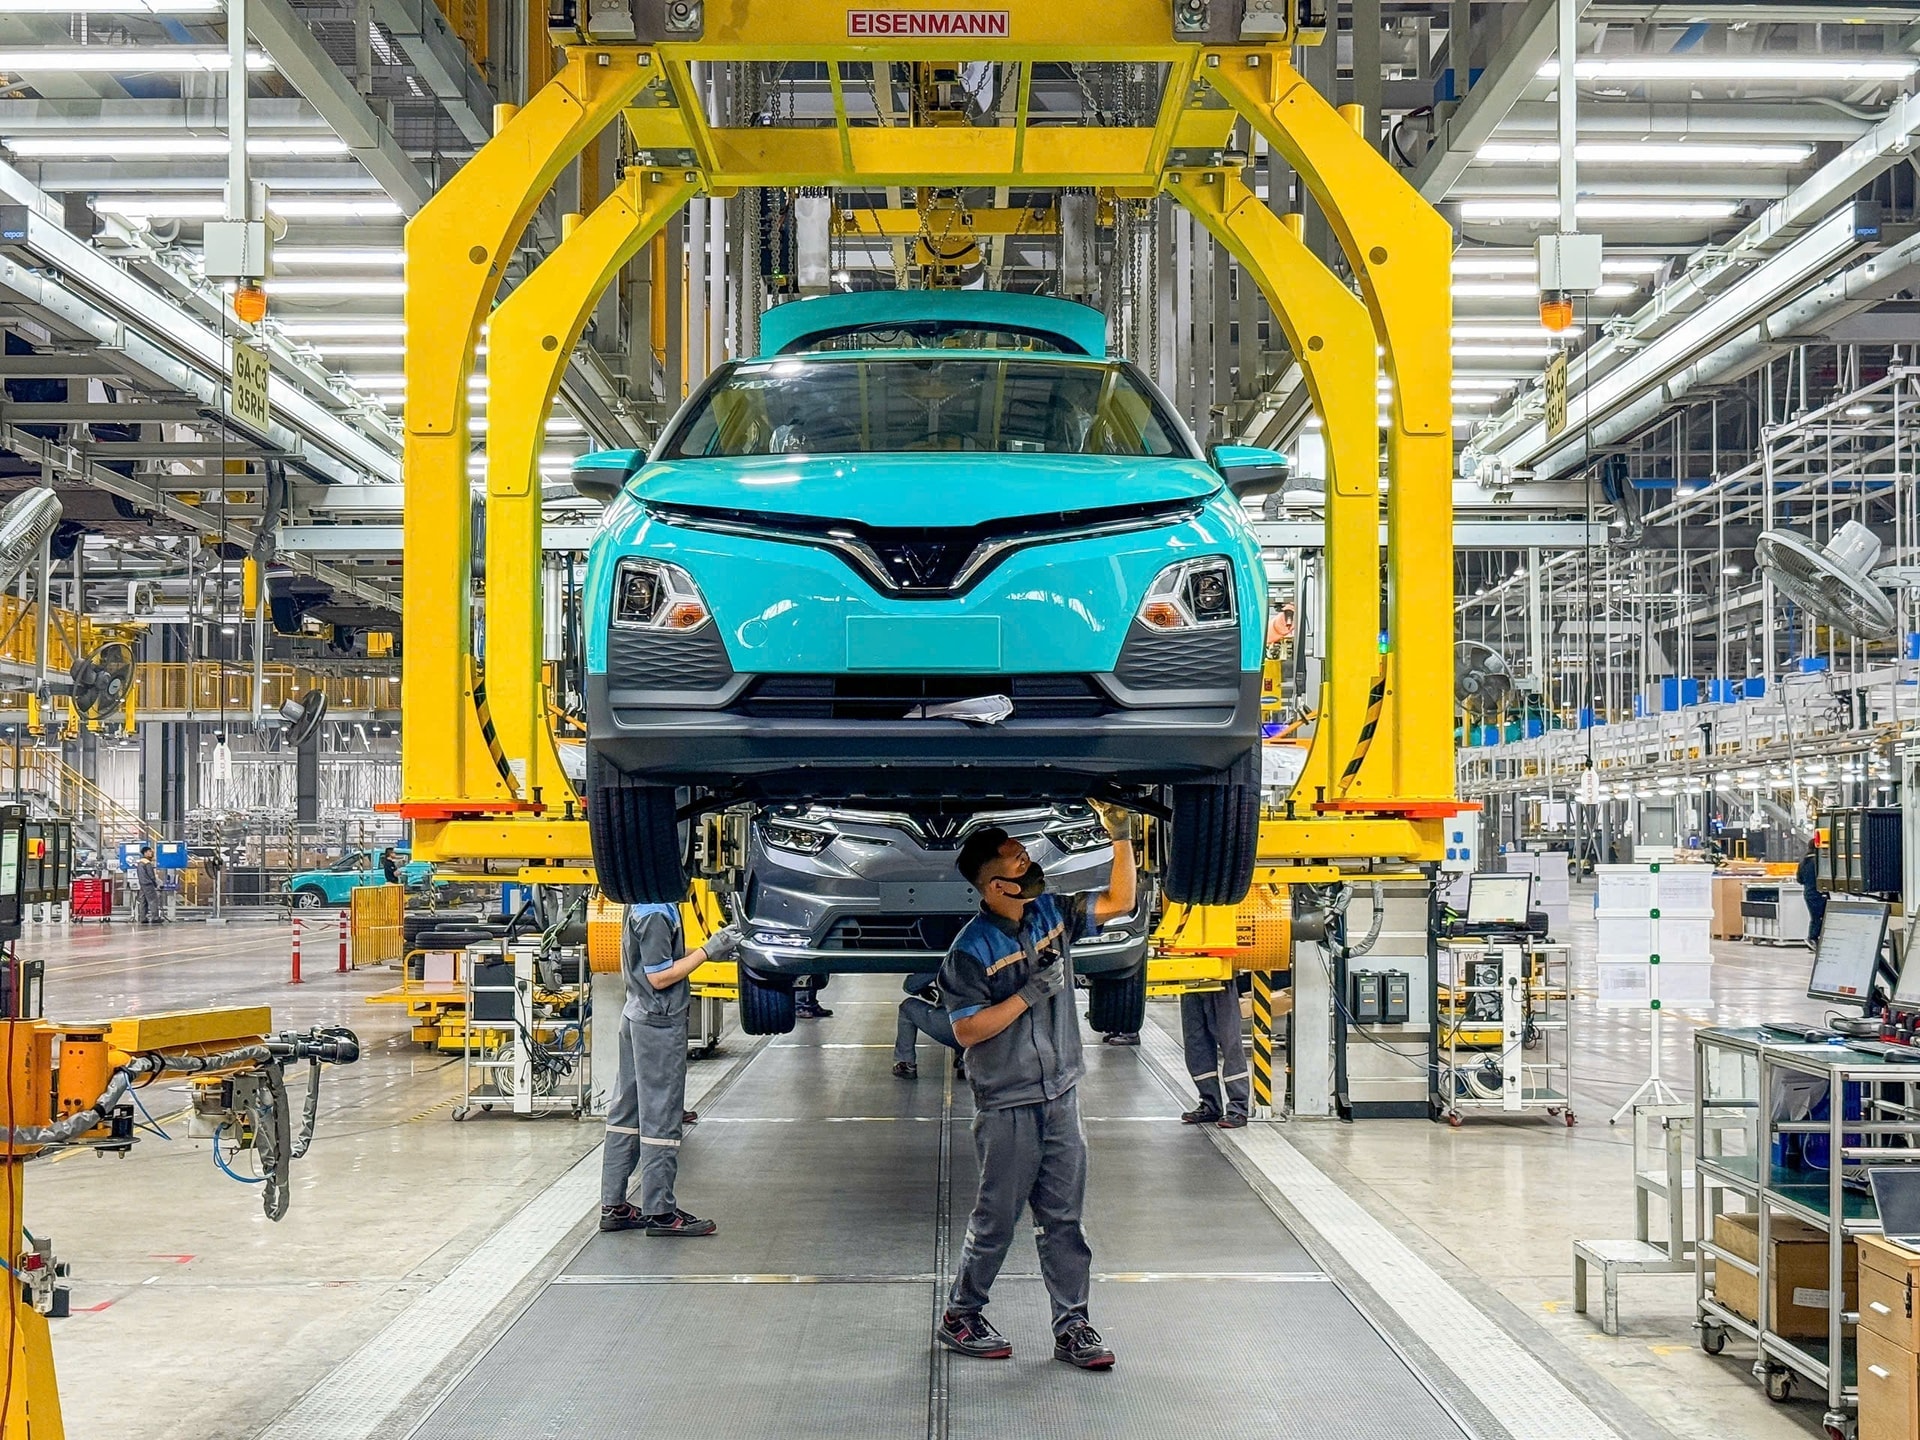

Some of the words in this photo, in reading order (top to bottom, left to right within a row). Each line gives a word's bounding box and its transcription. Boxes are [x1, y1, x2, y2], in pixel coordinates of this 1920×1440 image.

[852, 14, 1005, 34] EISENMANN
[236, 352, 267, 393] GA-C3
[732, 379, 790, 390] TAXI
[1545, 365, 1565, 403] GA-C3
[237, 384, 265, 423] 35RH
[1547, 396, 1563, 432] 35LH
